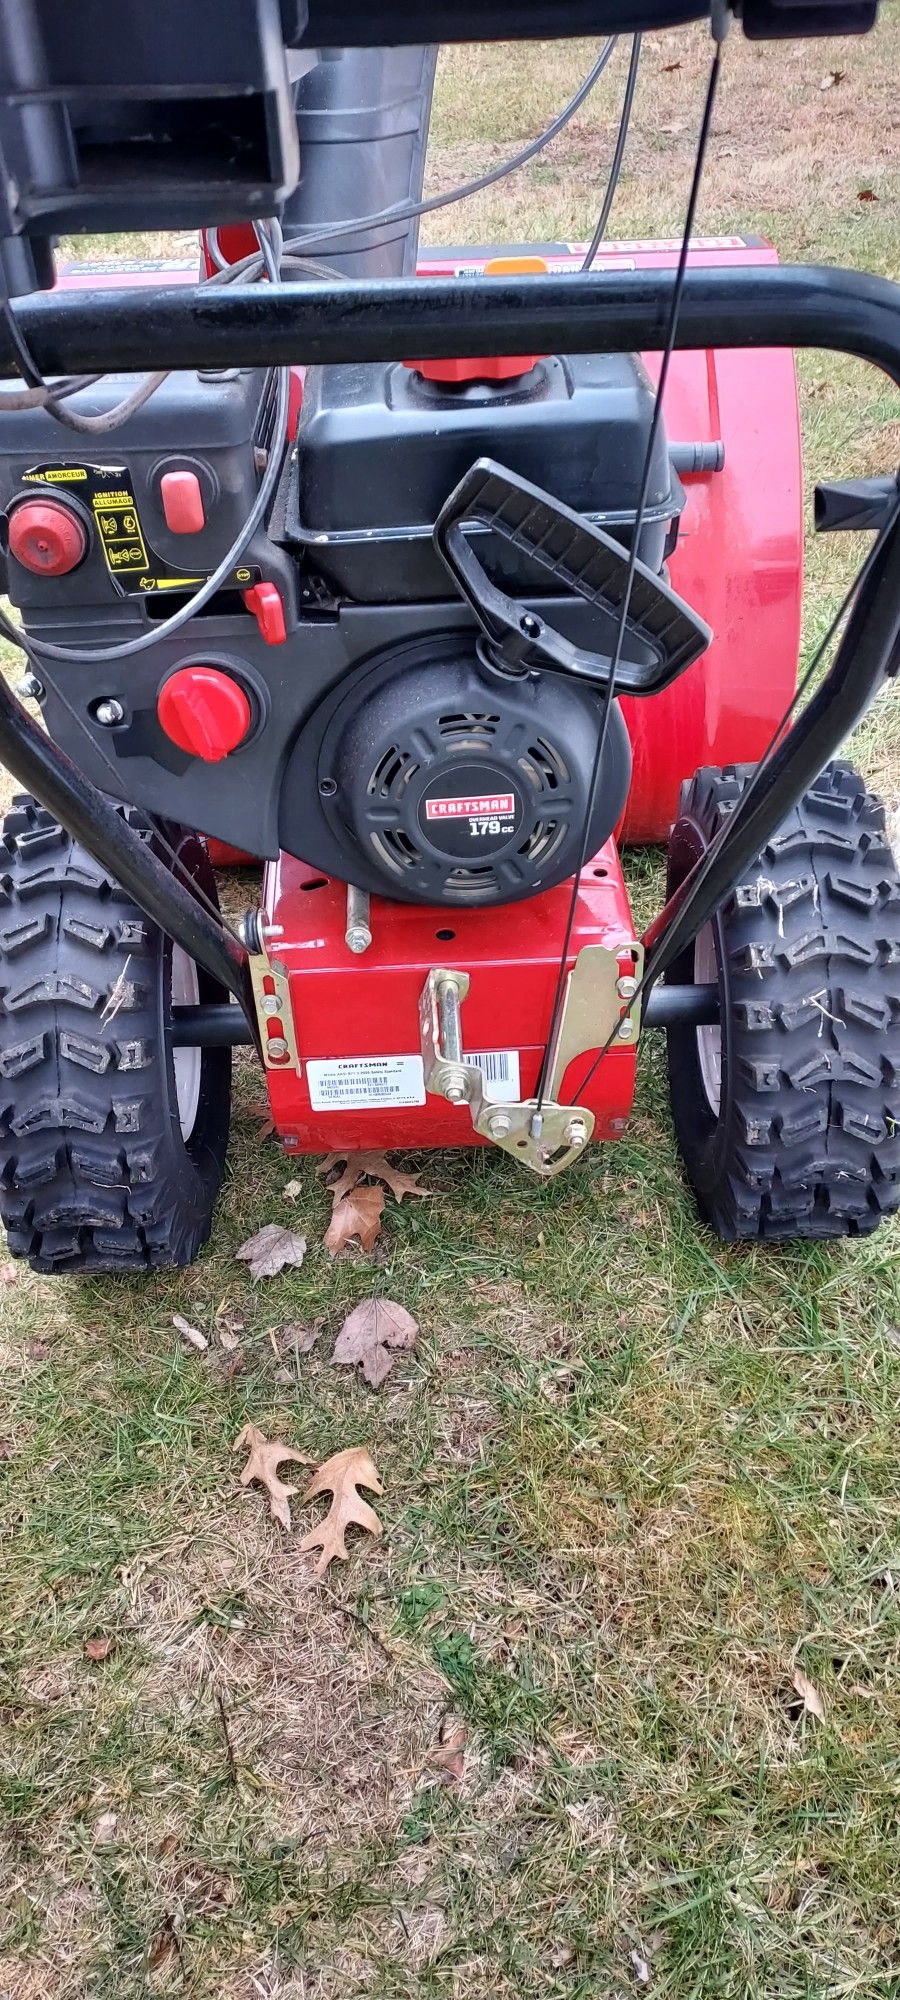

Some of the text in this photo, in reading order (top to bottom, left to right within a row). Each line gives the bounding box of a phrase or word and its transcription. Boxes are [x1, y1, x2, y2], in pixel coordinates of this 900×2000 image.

[47, 471, 85, 480] AMORCEUR
[94, 490, 128, 499] IGNITION
[94, 498, 133, 506] ALLUMAGE
[431, 798, 509, 814] CRAFTSMAN
[470, 820, 500, 835] 179
